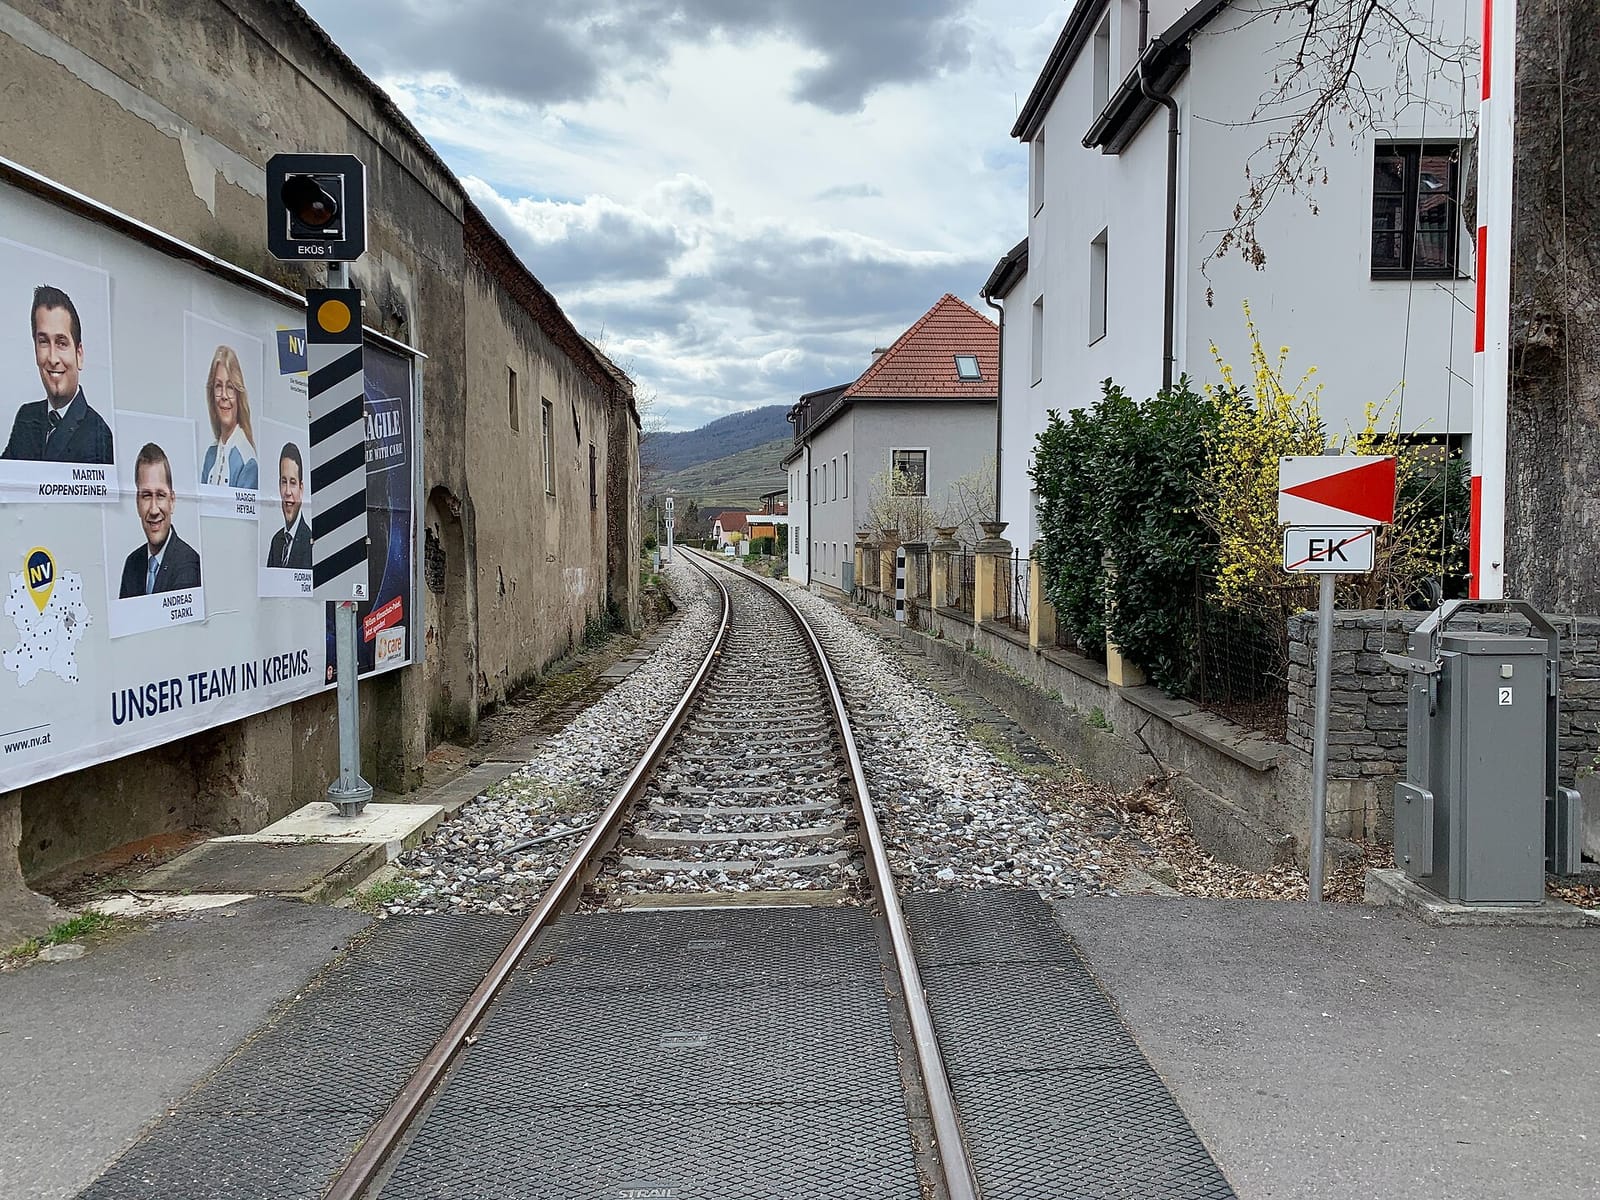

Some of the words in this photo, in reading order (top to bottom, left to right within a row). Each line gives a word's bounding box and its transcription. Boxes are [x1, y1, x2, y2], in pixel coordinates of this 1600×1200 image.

[298, 245, 324, 254] EKÜS
[327, 246, 332, 254] 1
[289, 335, 304, 356] NV
[366, 411, 400, 441] AGILE
[72, 469, 105, 481] MARTIN
[38, 484, 107, 496] KOPPENSTEINER
[235, 492, 256, 502] MARGIT
[1309, 539, 1348, 561] EK
[30, 562, 51, 584] NV
[355, 585, 363, 594] 2
[162, 594, 193, 608] ANDREAS
[170, 607, 193, 620] STARKL
[111, 678, 183, 725] UNSER
[188, 666, 237, 704] TEAM
[241, 661, 258, 690] IN
[262, 649, 312, 686] KREMS.
[1501, 690, 1510, 703] 2
[4, 733, 51, 754] www.nv.at
